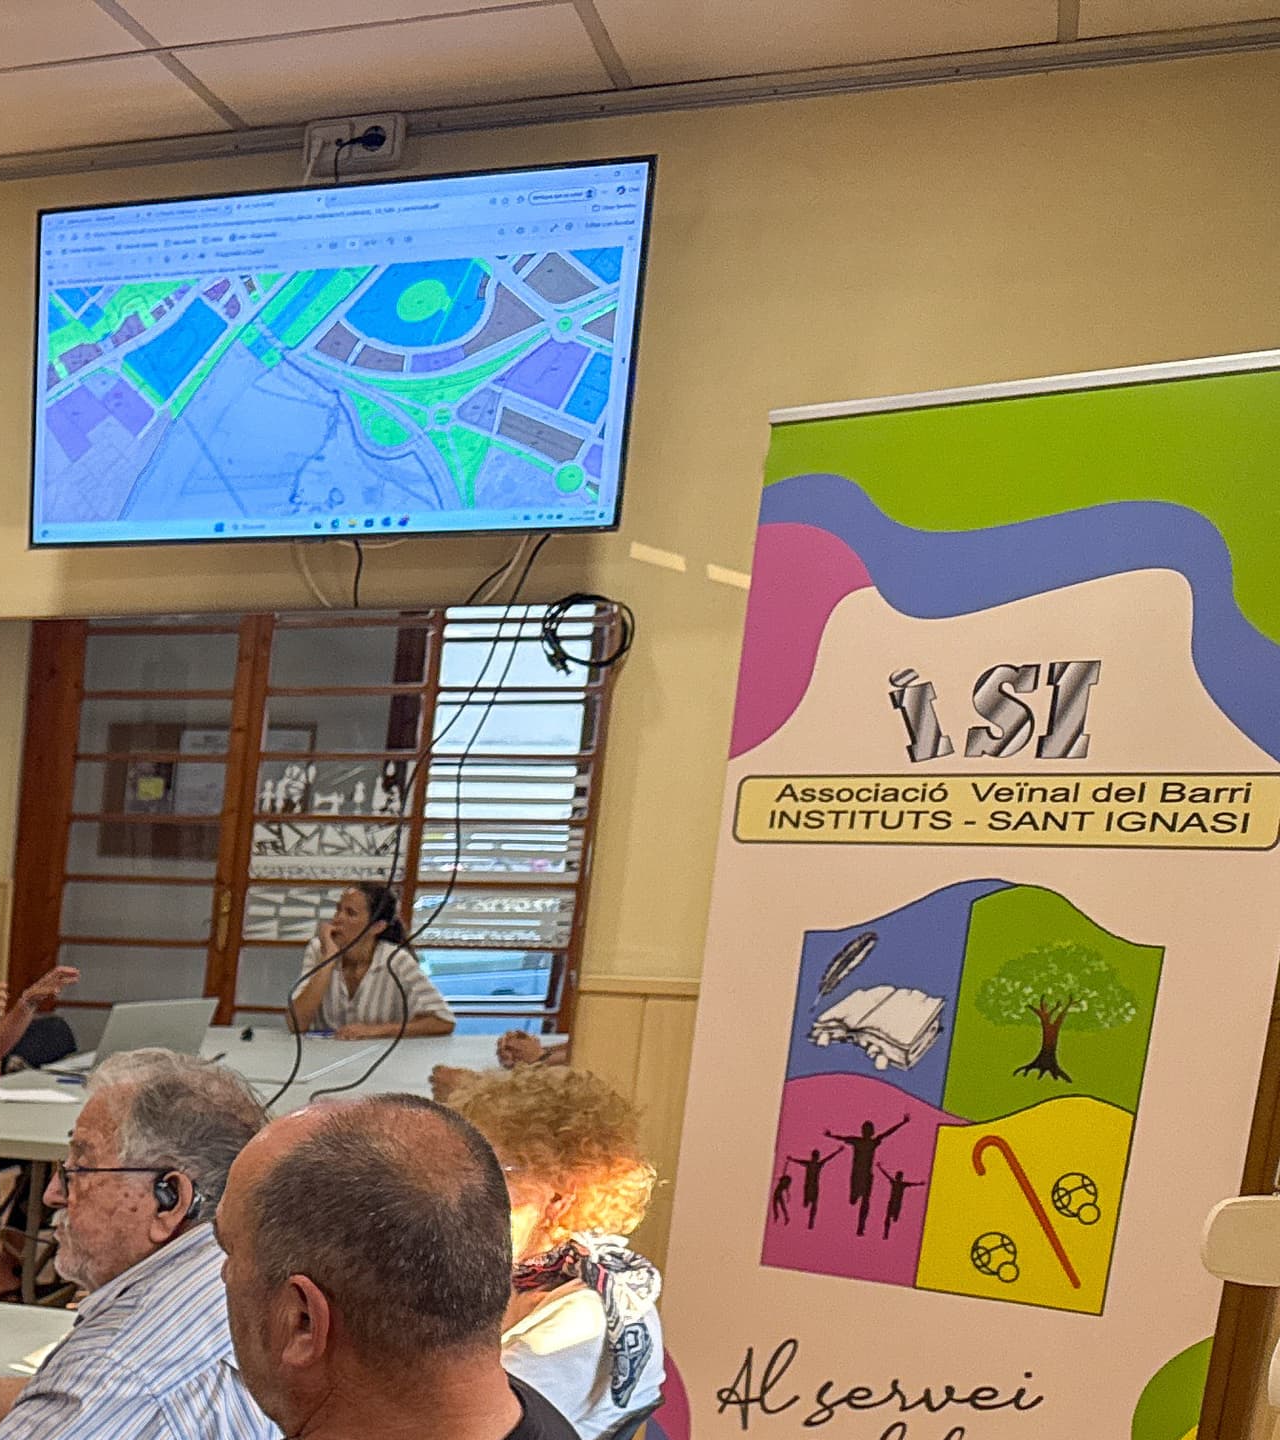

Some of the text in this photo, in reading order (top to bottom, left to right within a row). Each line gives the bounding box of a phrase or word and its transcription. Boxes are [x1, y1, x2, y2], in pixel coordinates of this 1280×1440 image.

[775, 781, 1252, 805] Associació Veïnal del Barri
[768, 808, 952, 832] INSTITUTS
[987, 809, 1094, 833] SANT
[1104, 811, 1251, 835] IGNASI
[716, 1338, 1044, 1431] Al servei
